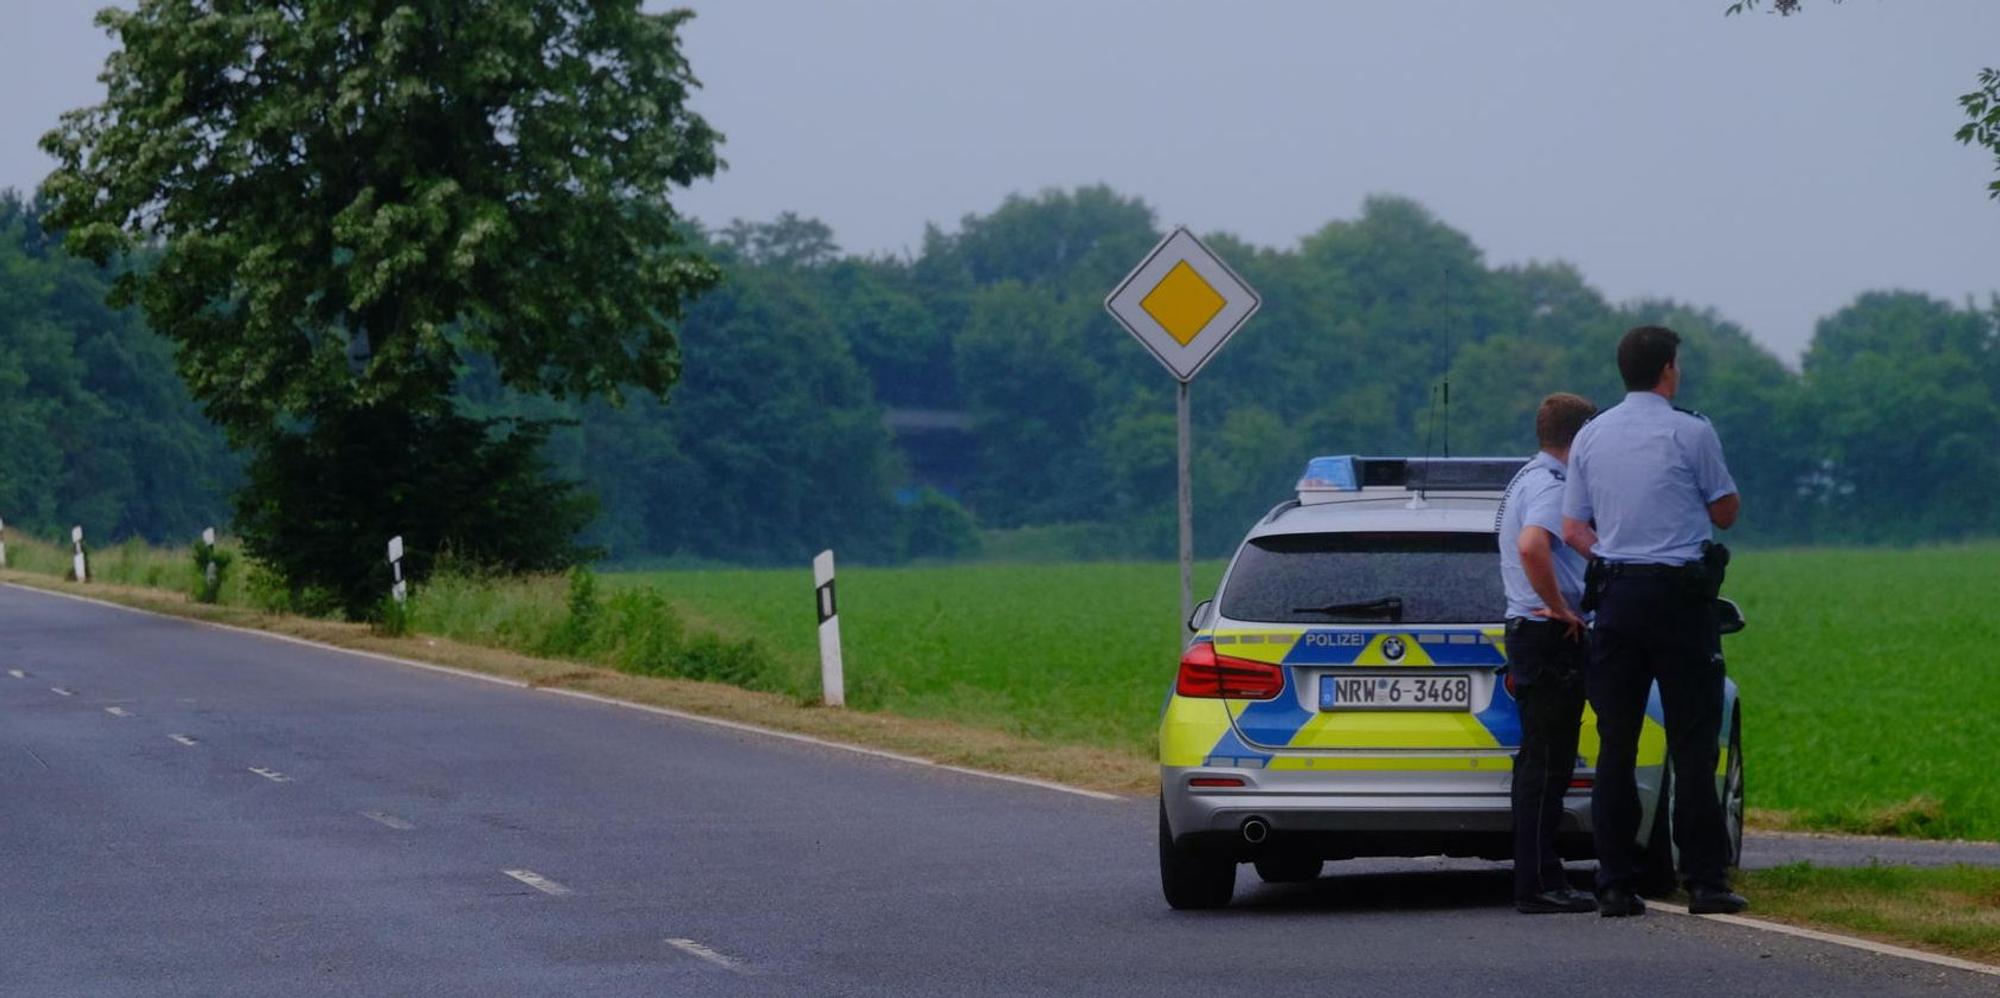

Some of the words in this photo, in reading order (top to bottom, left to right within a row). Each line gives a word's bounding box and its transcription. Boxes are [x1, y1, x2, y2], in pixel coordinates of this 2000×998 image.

[1306, 634, 1365, 646] POLIZEI
[1335, 680, 1376, 702] NRW
[1389, 680, 1467, 702] 6-3468
